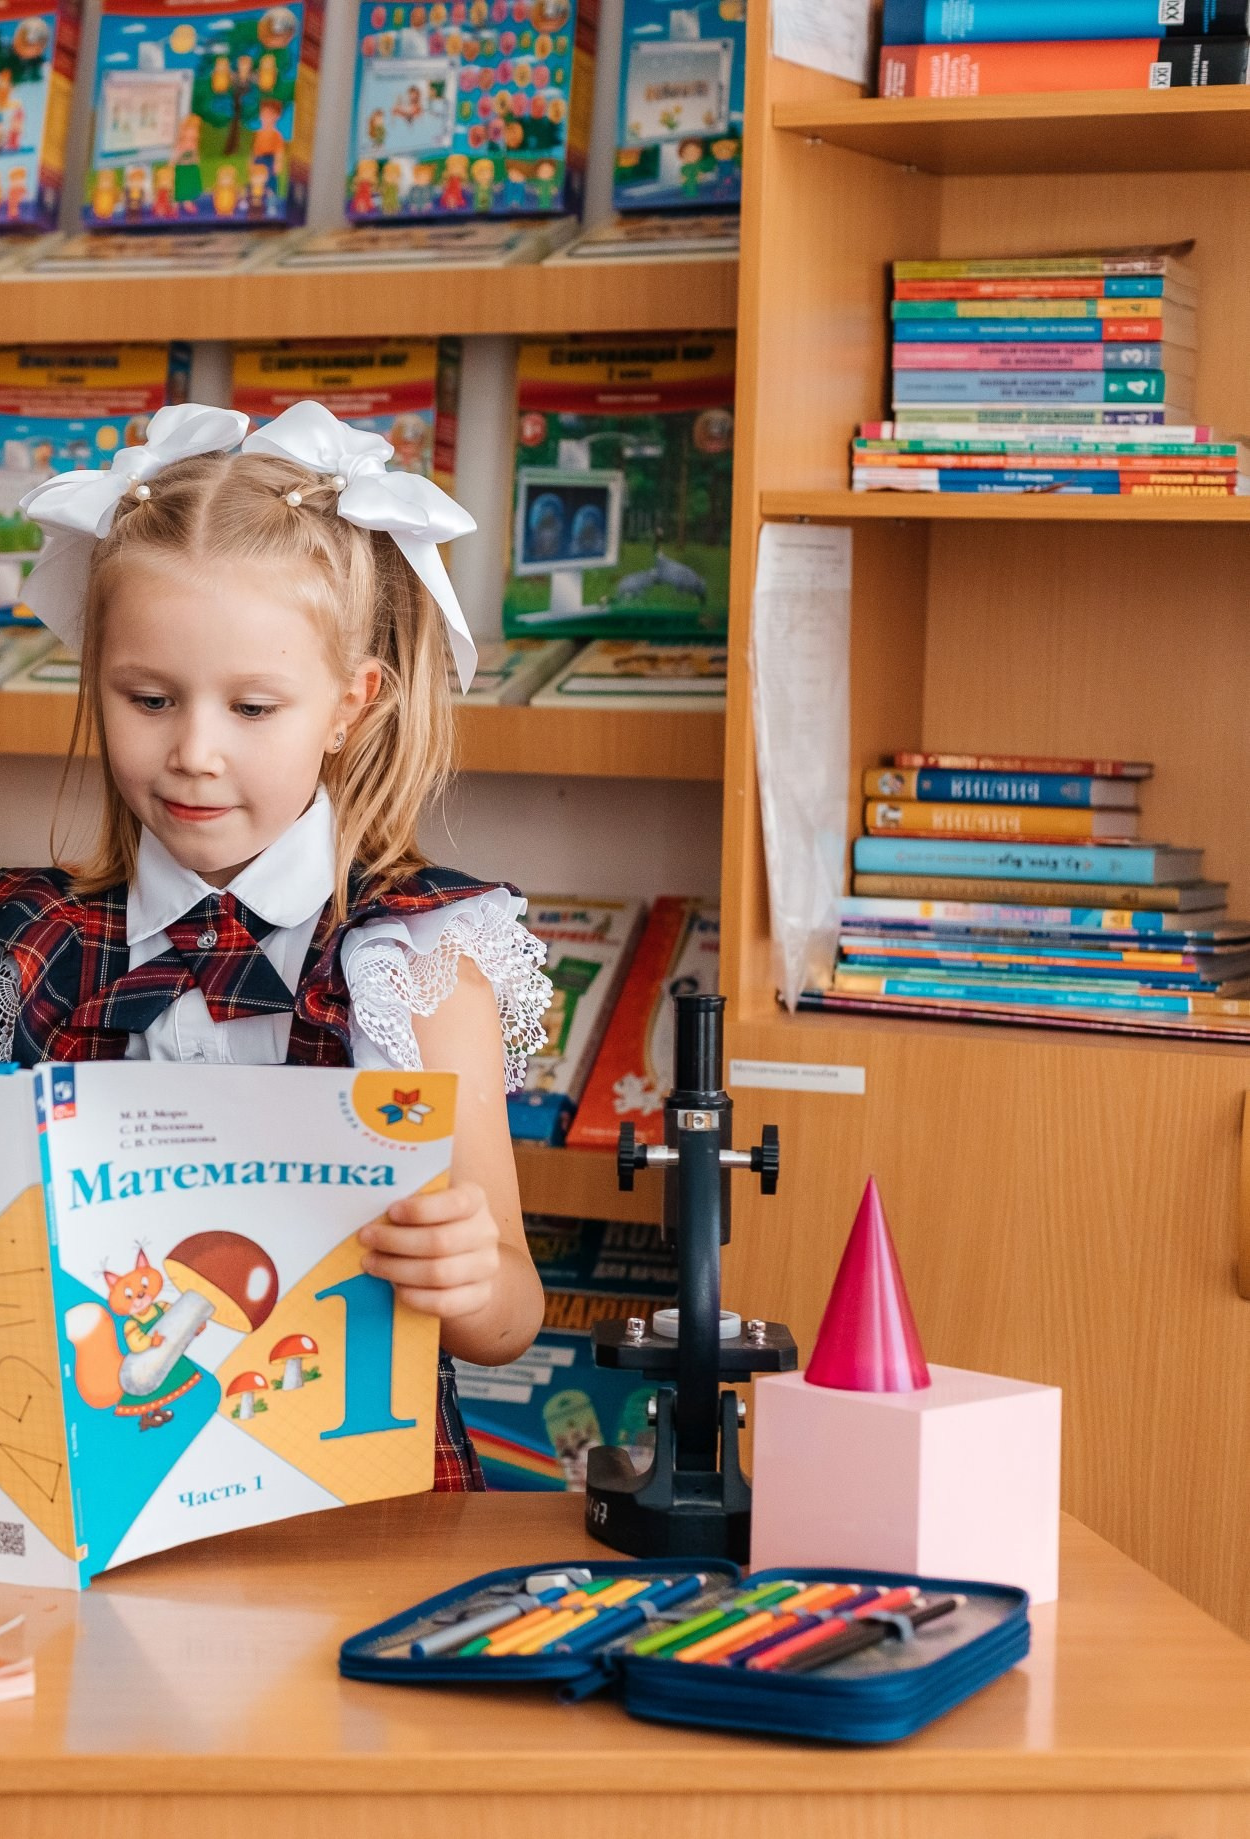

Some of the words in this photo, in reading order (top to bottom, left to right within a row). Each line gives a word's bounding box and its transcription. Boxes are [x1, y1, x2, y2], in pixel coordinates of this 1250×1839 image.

[1131, 485, 1228, 497] МАТЕМАТИКА
[68, 1160, 397, 1210] Математика
[314, 1273, 417, 1440] 1
[179, 1482, 247, 1507] Часть
[253, 1474, 264, 1491] 1
